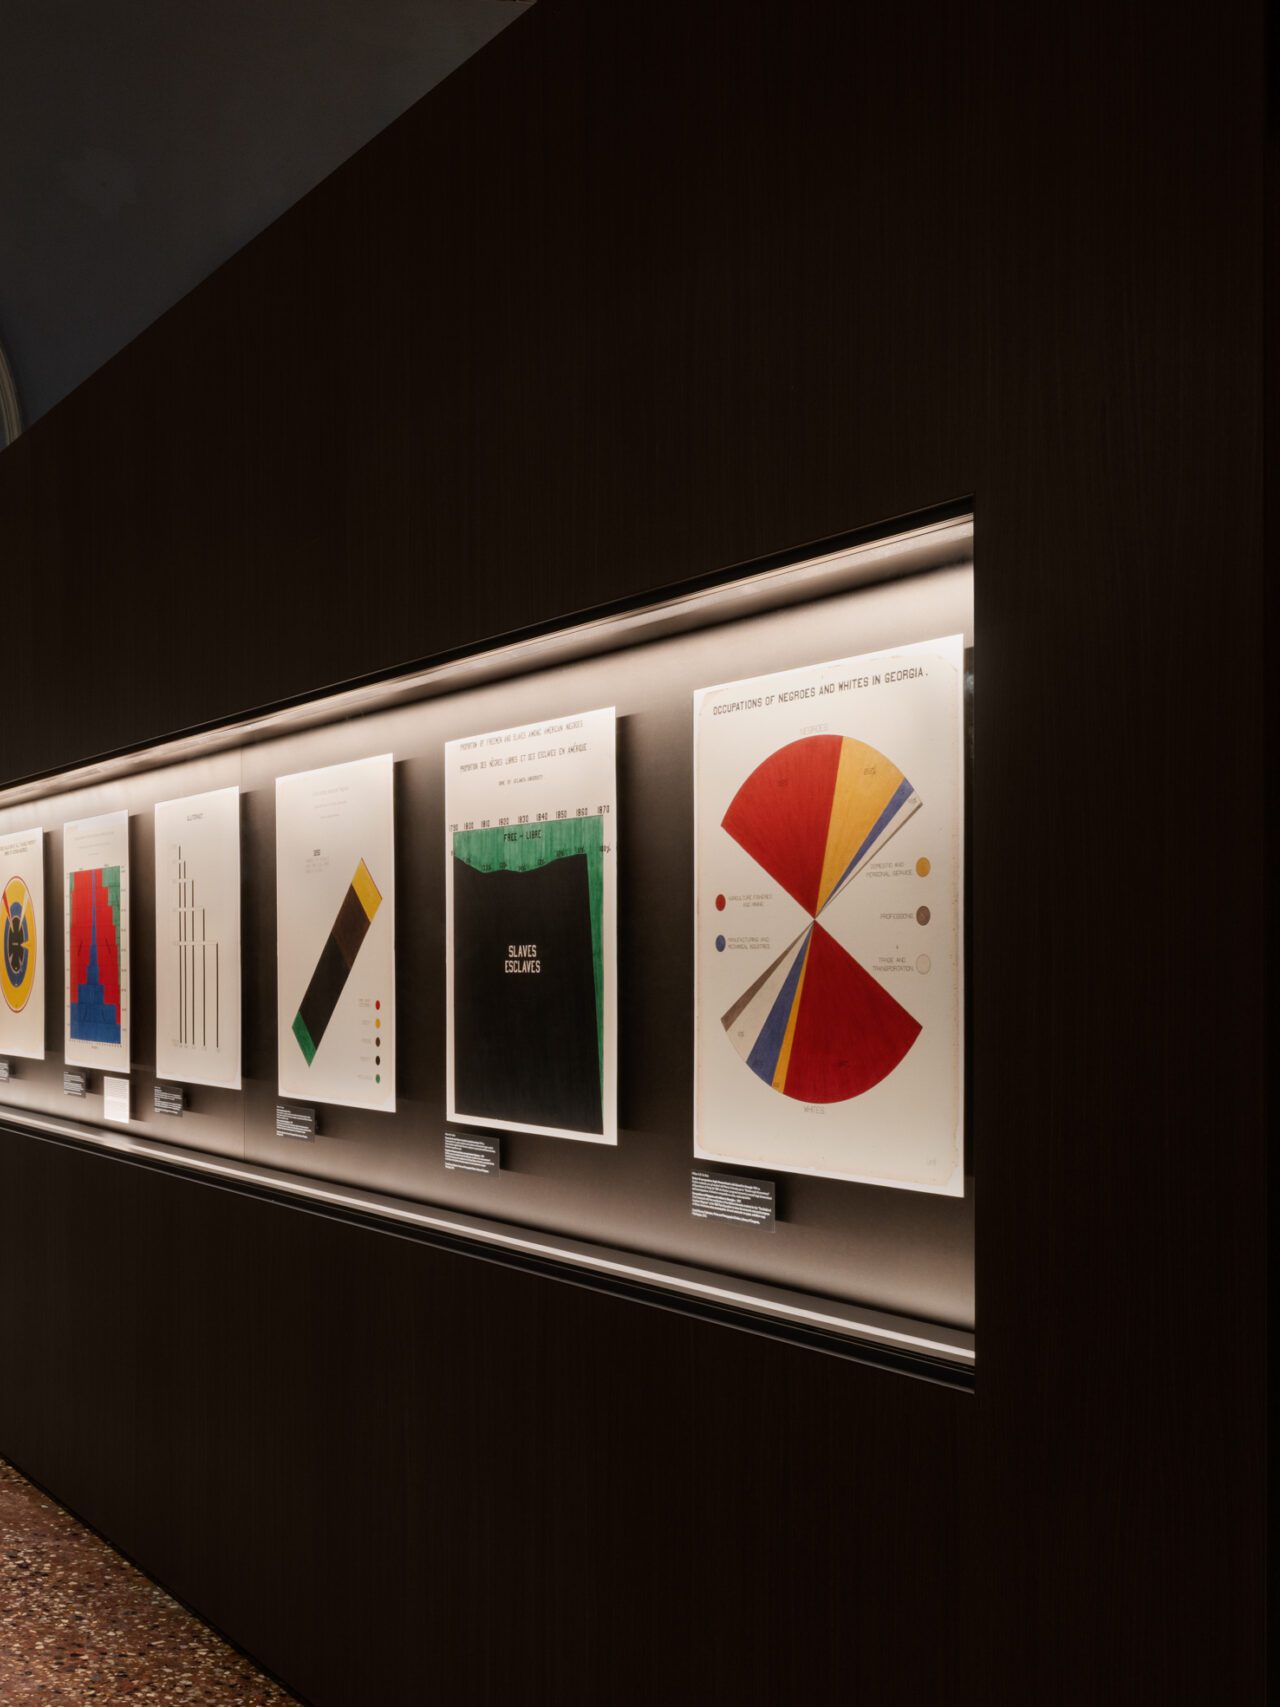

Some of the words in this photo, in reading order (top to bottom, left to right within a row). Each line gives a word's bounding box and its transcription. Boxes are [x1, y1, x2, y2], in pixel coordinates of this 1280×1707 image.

[713, 697, 763, 716] OCCUPATIONS
[765, 695, 776, 709] OF
[778, 687, 816, 703] NEGROES
[819, 682, 836, 696] AND
[838, 676, 869, 691] WHITES
[872, 675, 881, 686] IN
[536, 812, 548, 821] 1840
[556, 809, 567, 819] 1850
[576, 807, 588, 817] 1860
[597, 805, 610, 814] 1870
[504, 832, 517, 842] FREE
[526, 829, 542, 840] LIBRE
[508, 945, 537, 958] SLAVES
[504, 960, 541, 973] ESCLAVES
